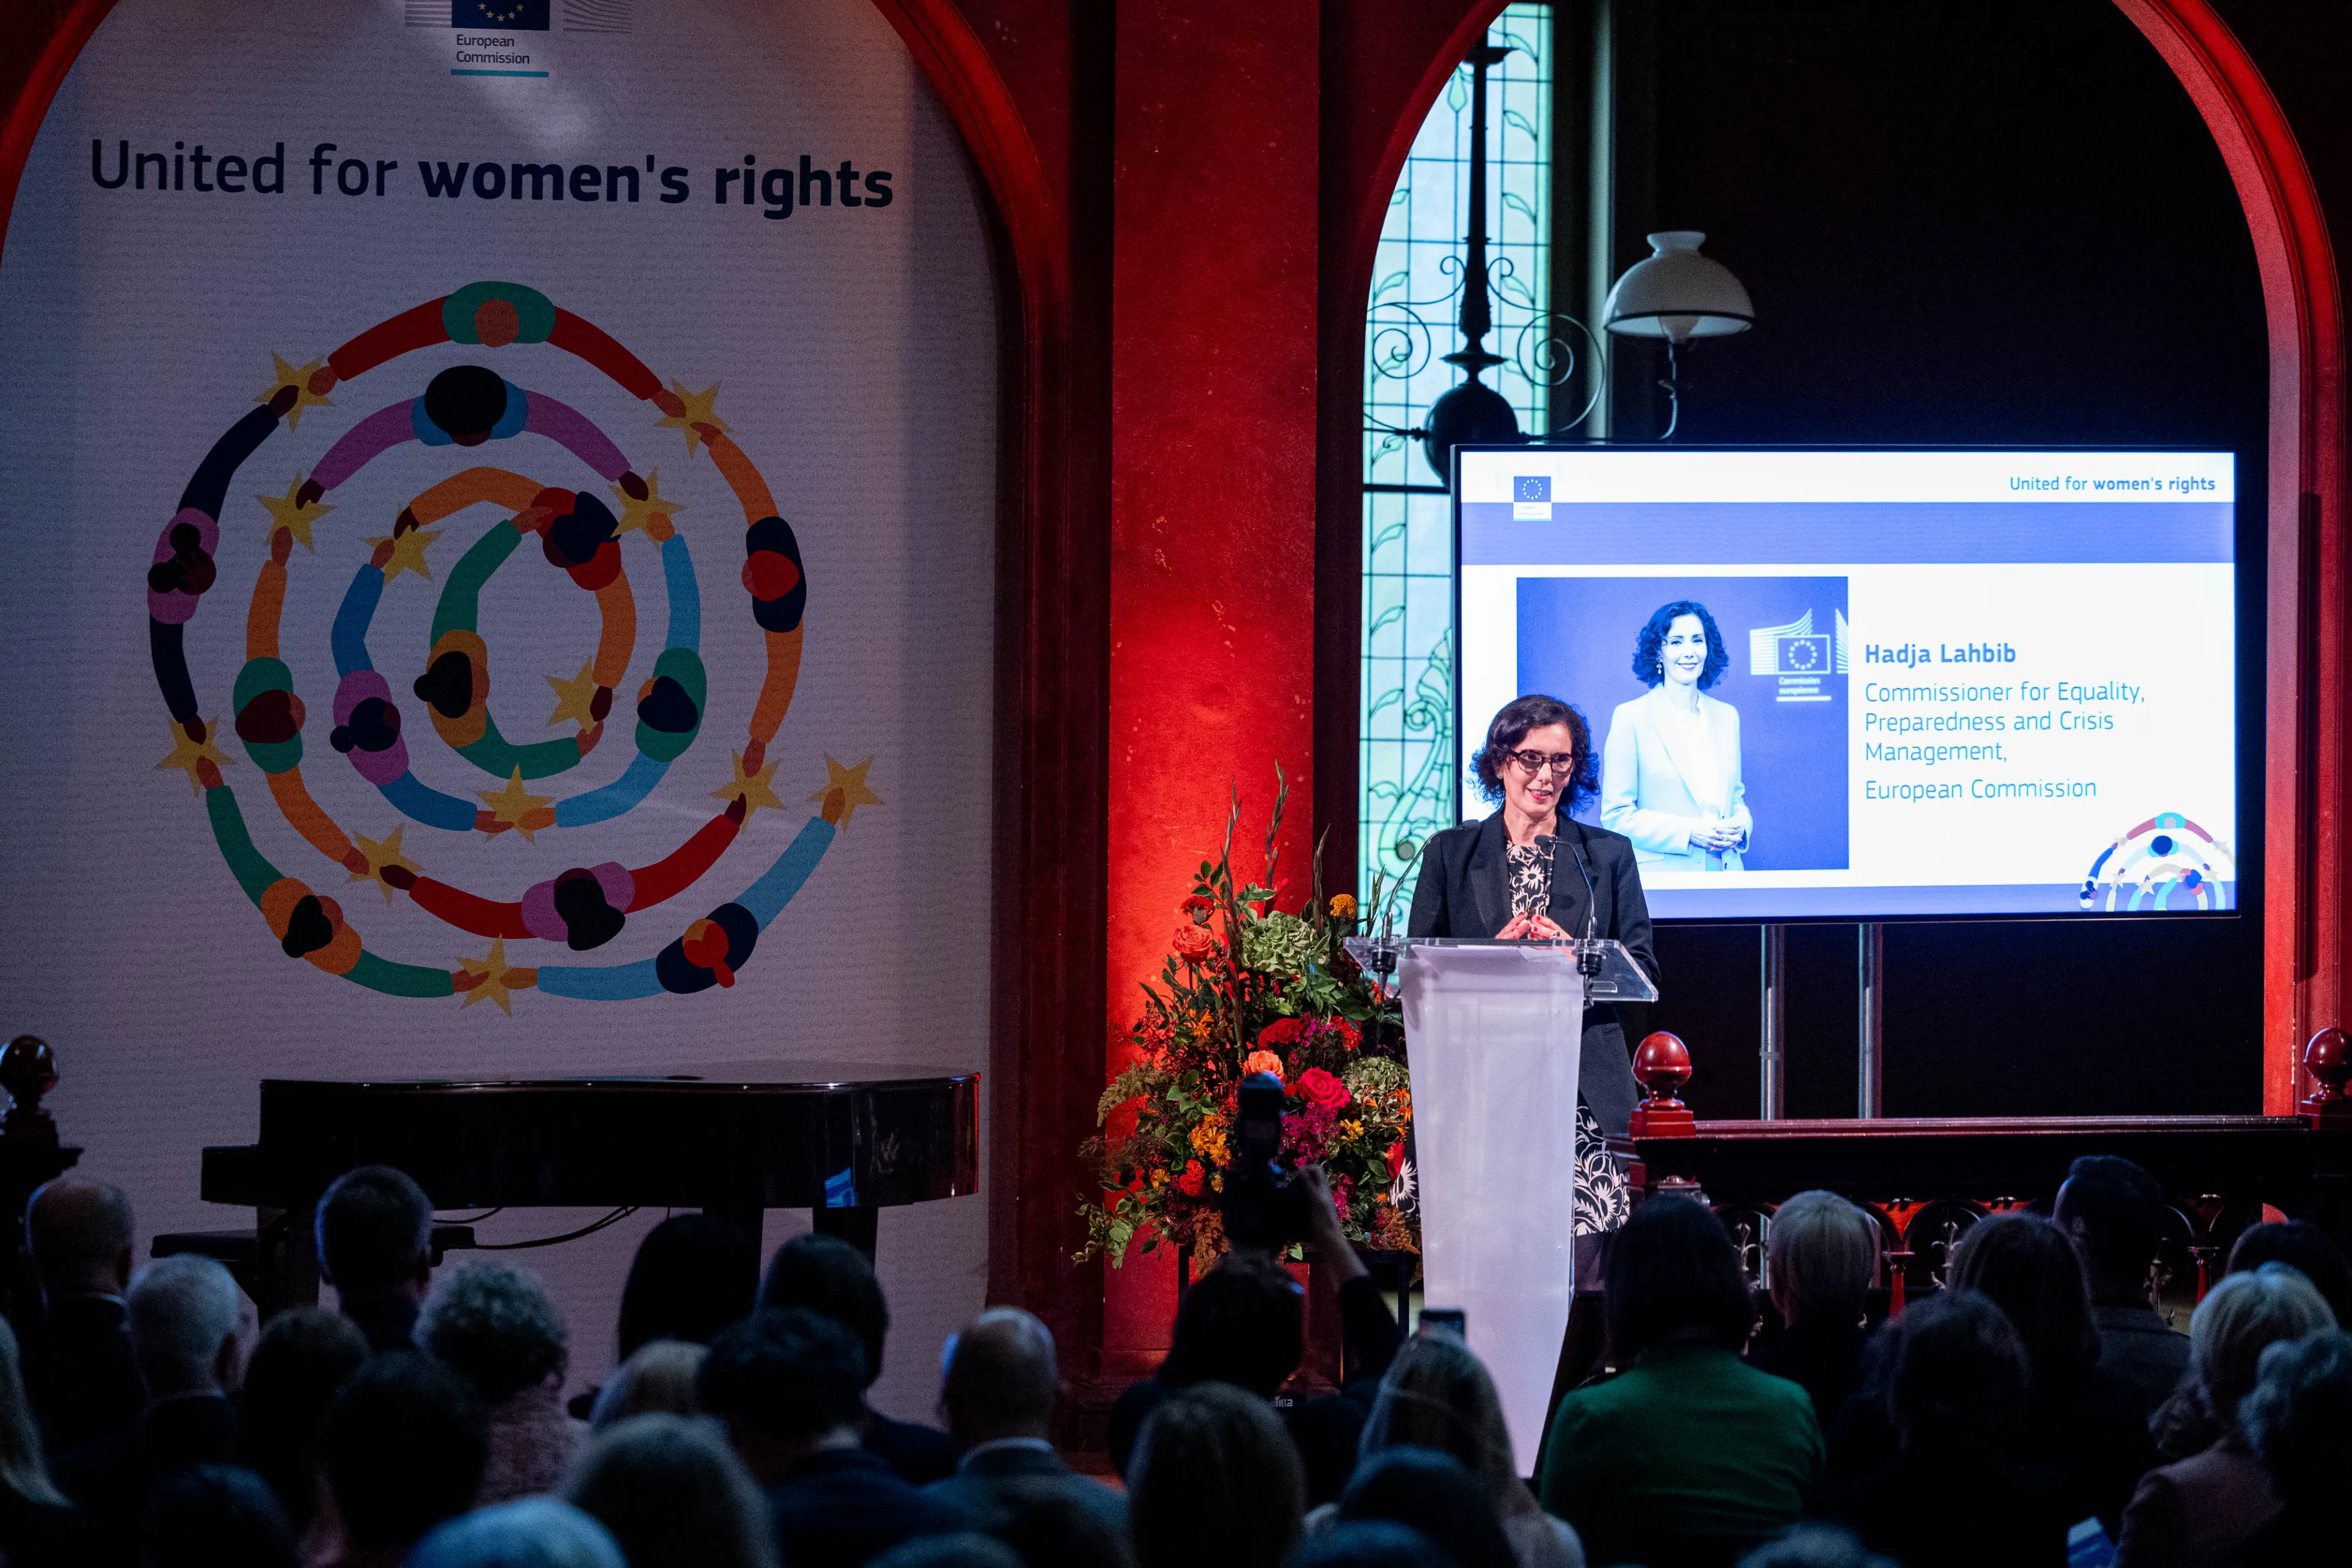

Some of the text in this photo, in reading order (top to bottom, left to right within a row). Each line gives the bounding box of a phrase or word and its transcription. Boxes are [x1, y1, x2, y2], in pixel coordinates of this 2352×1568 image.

[456, 34, 514, 48] European
[456, 51, 530, 64] Commission
[92, 139, 894, 221] United for women's rights
[2010, 477, 2216, 494] United for women's rights
[1866, 643, 2016, 668] Hadja Lahbib
[1866, 681, 2146, 706] Commissioner for Equality,
[1866, 710, 2114, 736] Preparedness and Crisis
[1866, 742, 2008, 766] Management,
[1866, 779, 2097, 804] European Commission
